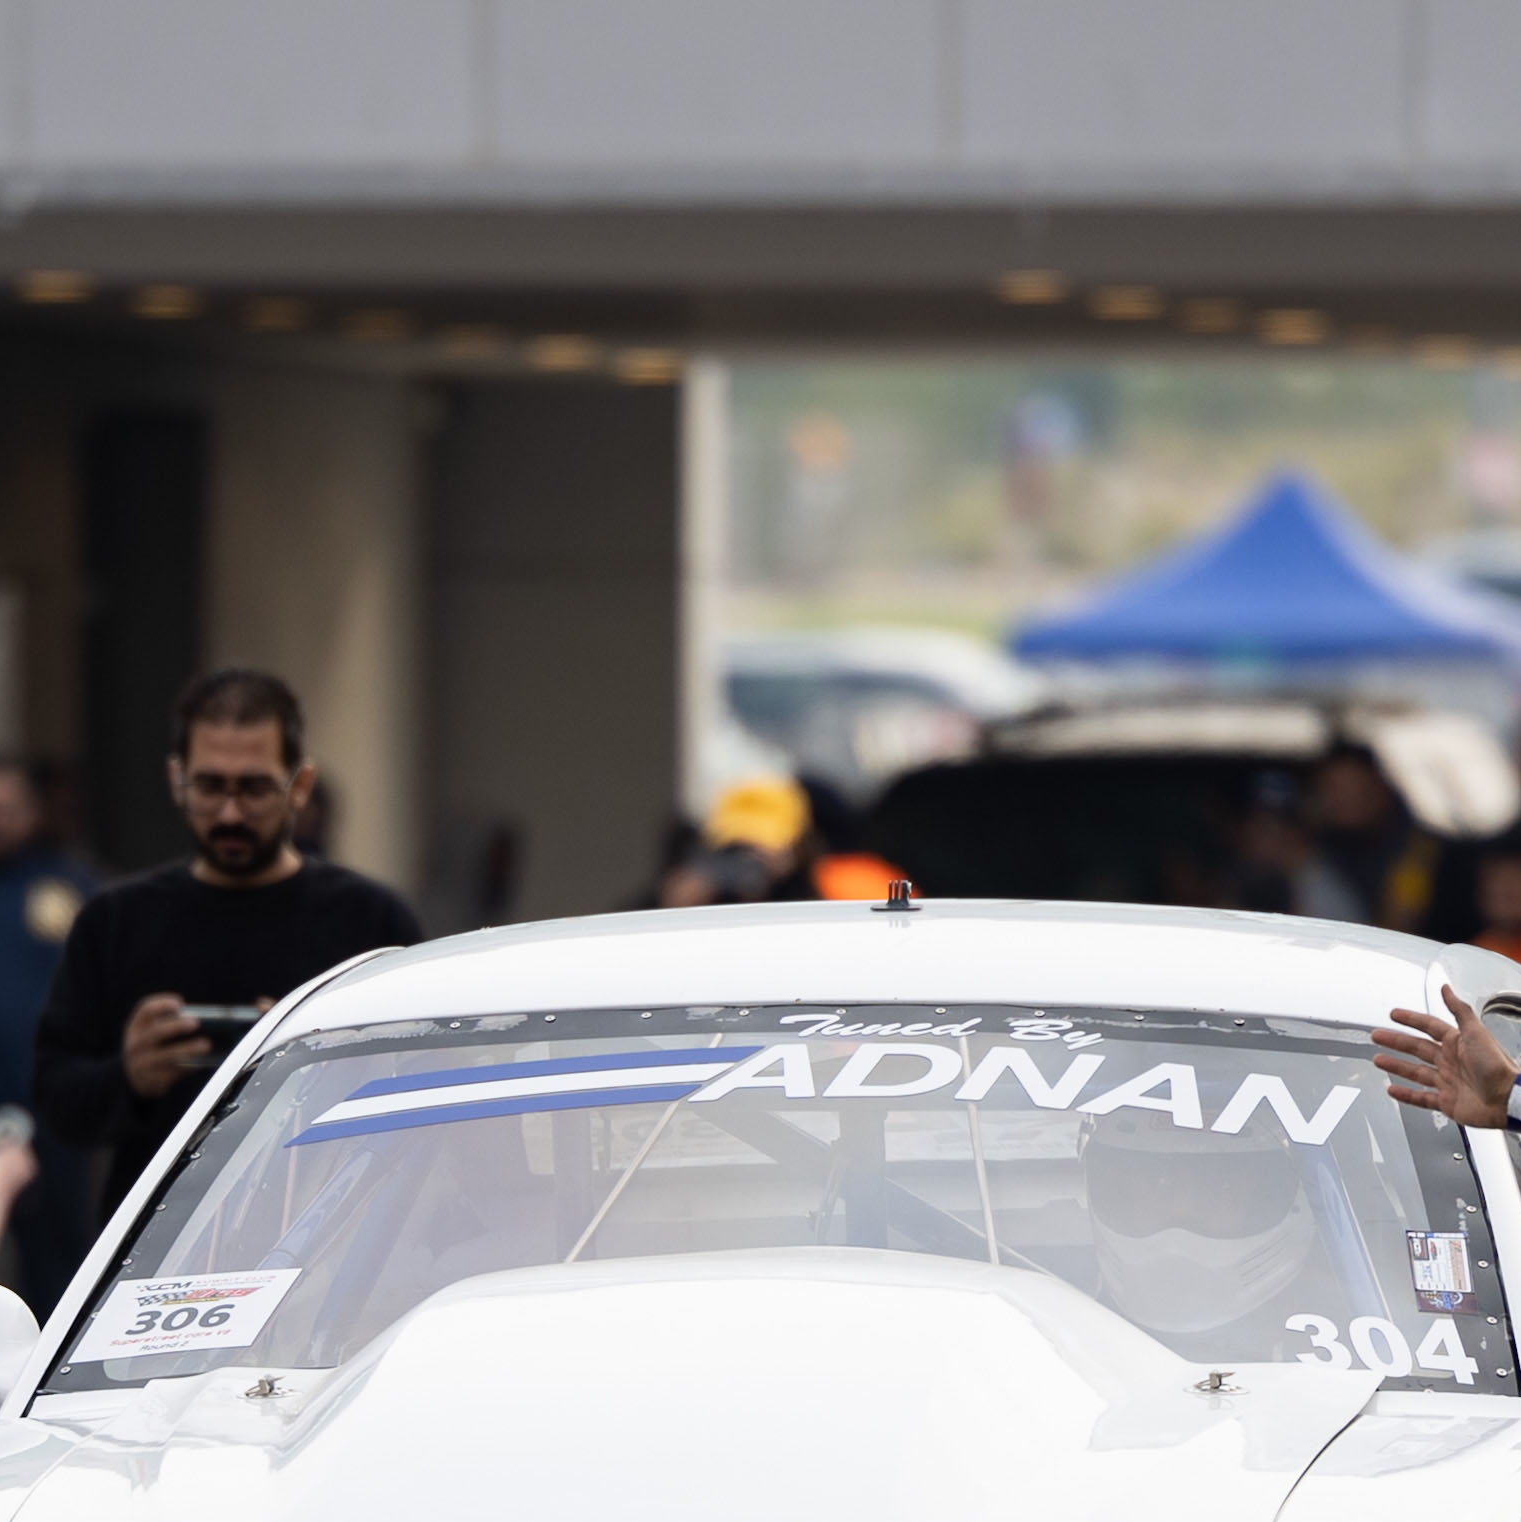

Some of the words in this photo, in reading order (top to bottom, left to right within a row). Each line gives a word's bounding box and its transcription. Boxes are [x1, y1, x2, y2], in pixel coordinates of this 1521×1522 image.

[779, 1013, 982, 1038] Tuned
[1009, 1019, 1105, 1050] By
[687, 1042, 1362, 1146] ADNAN
[125, 1304, 235, 1335] 306
[1285, 1313, 1479, 1385] 304
